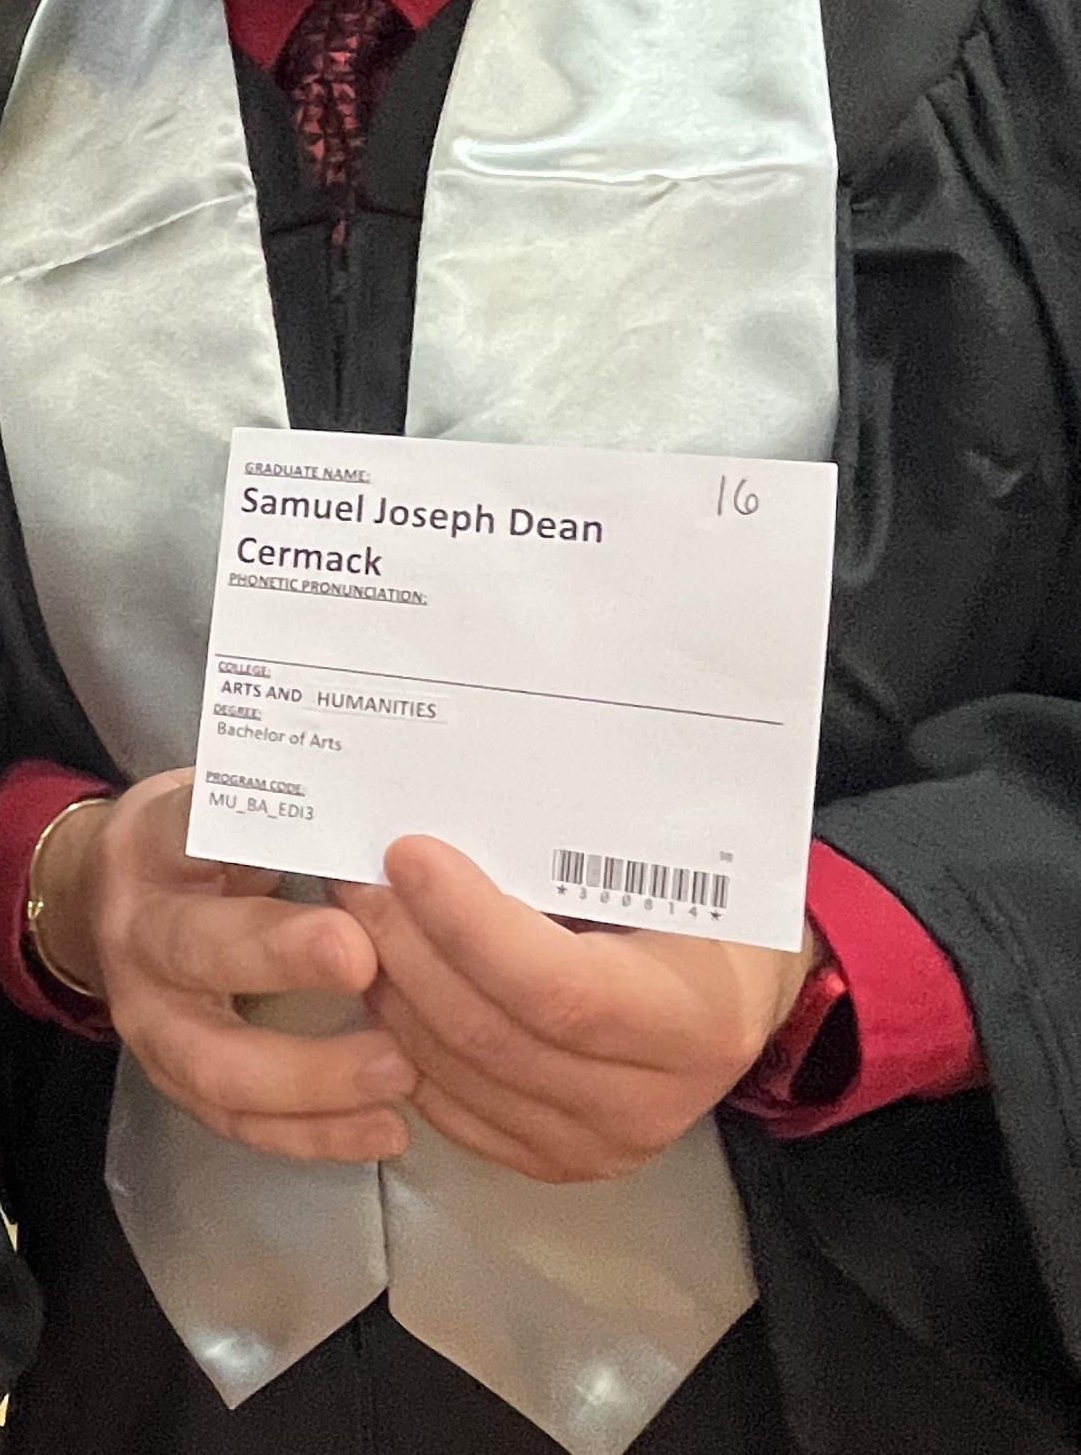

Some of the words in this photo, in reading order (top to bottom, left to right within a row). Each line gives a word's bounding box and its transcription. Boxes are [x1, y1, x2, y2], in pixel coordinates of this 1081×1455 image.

[244, 461, 319, 479] GRADUATE
[323, 467, 371, 484] NAME:
[717, 474, 759, 516] 16
[241, 487, 364, 524] Samuel
[374, 497, 495, 538] Joseph
[509, 508, 604, 543] Dean
[237, 537, 382, 576] Cermack
[228, 572, 298, 592] PHONETIC
[301, 580, 427, 605] PRONUNCIATION:
[220, 680, 262, 698] ARTS
[265, 686, 303, 702] AND
[317, 691, 438, 719] HUMANITIES
[216, 721, 287, 743] Bachelor
[289, 730, 307, 746] of
[310, 734, 344, 752] Arts
[205, 771, 267, 791] PROGRAM
